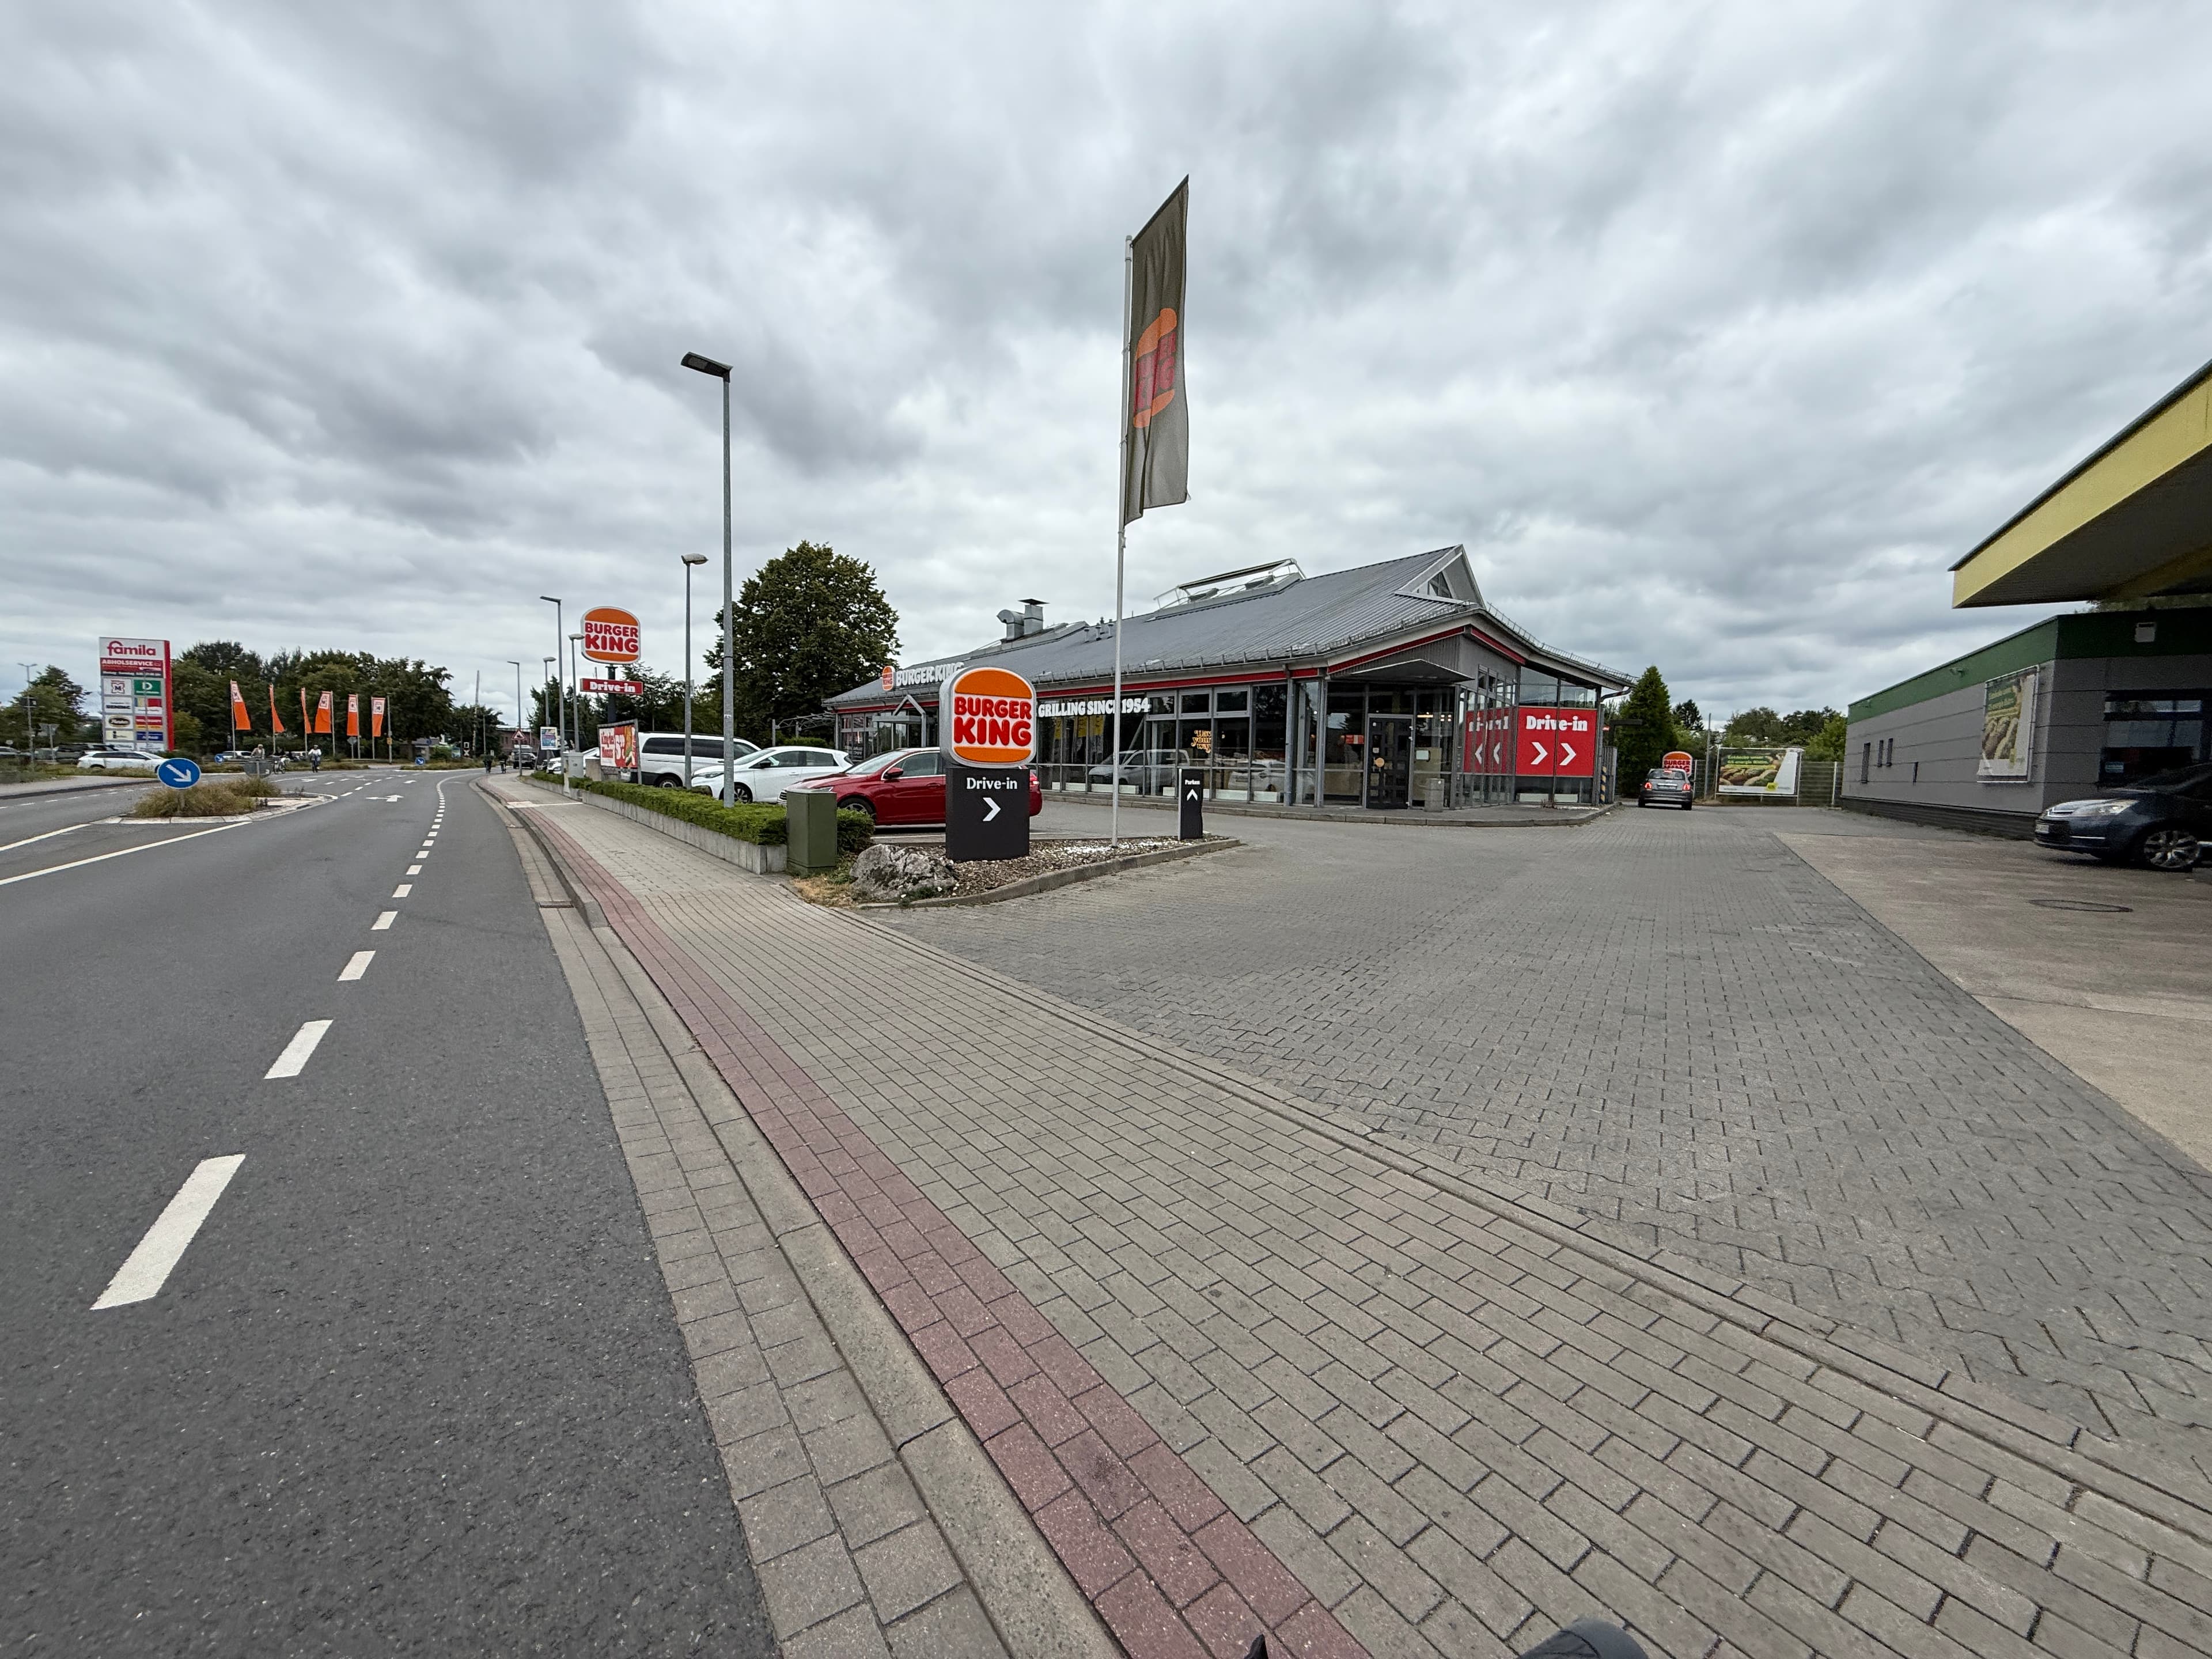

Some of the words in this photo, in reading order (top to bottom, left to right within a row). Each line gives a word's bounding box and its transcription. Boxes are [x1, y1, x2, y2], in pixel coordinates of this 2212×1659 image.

[585, 623, 638, 638] BURGER
[107, 641, 156, 656] famila
[585, 634, 638, 653] KING
[896, 666, 935, 687] BURGER
[589, 681, 636, 693] Drive-in
[955, 696, 1032, 719] BURGER
[1038, 701, 1086, 718] GRILLING
[1122, 697, 1151, 714] 1954
[954, 716, 1032, 747] KING
[1526, 714, 1588, 732] Drive-in
[1191, 737, 1211, 747] your
[966, 777, 1018, 790] Drive-in
